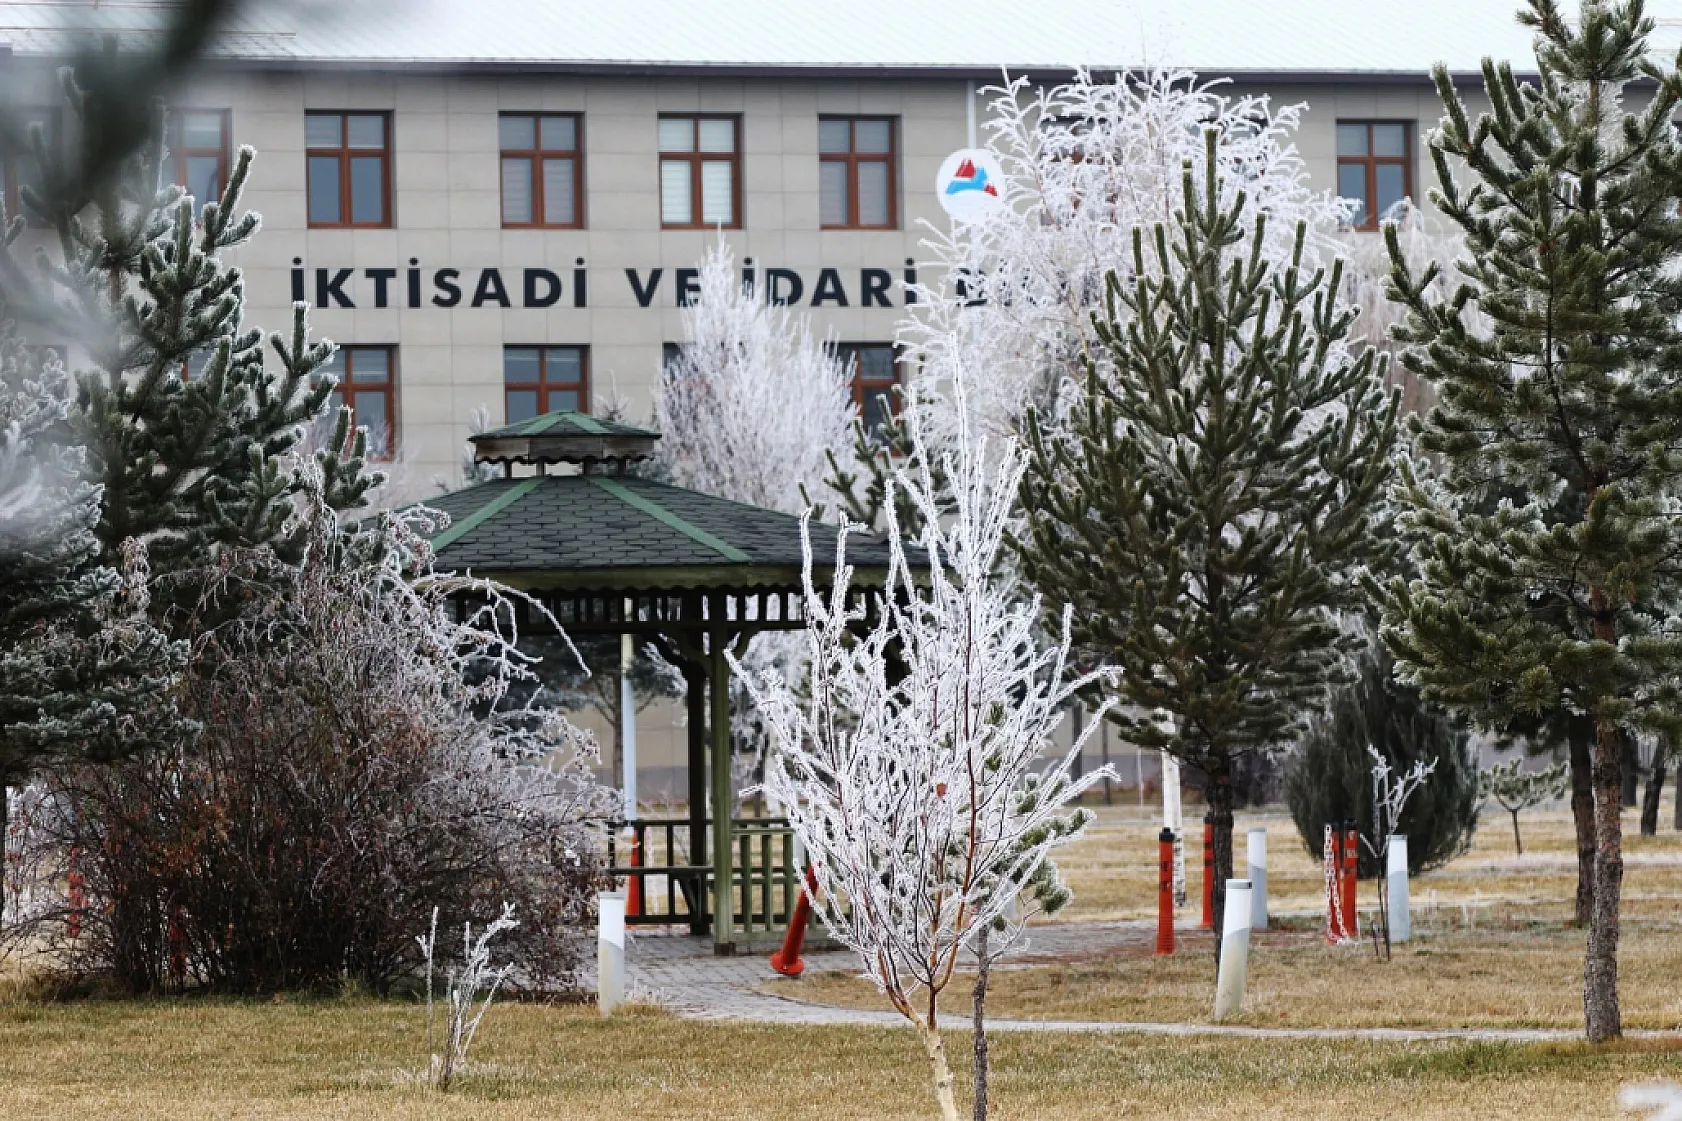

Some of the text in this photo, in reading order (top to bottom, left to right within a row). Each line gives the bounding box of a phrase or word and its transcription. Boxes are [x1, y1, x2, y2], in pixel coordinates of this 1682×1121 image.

[291, 257, 588, 308] İKTİSADİ
[624, 267, 701, 308] VE
[741, 257, 917, 308] İDARİ
